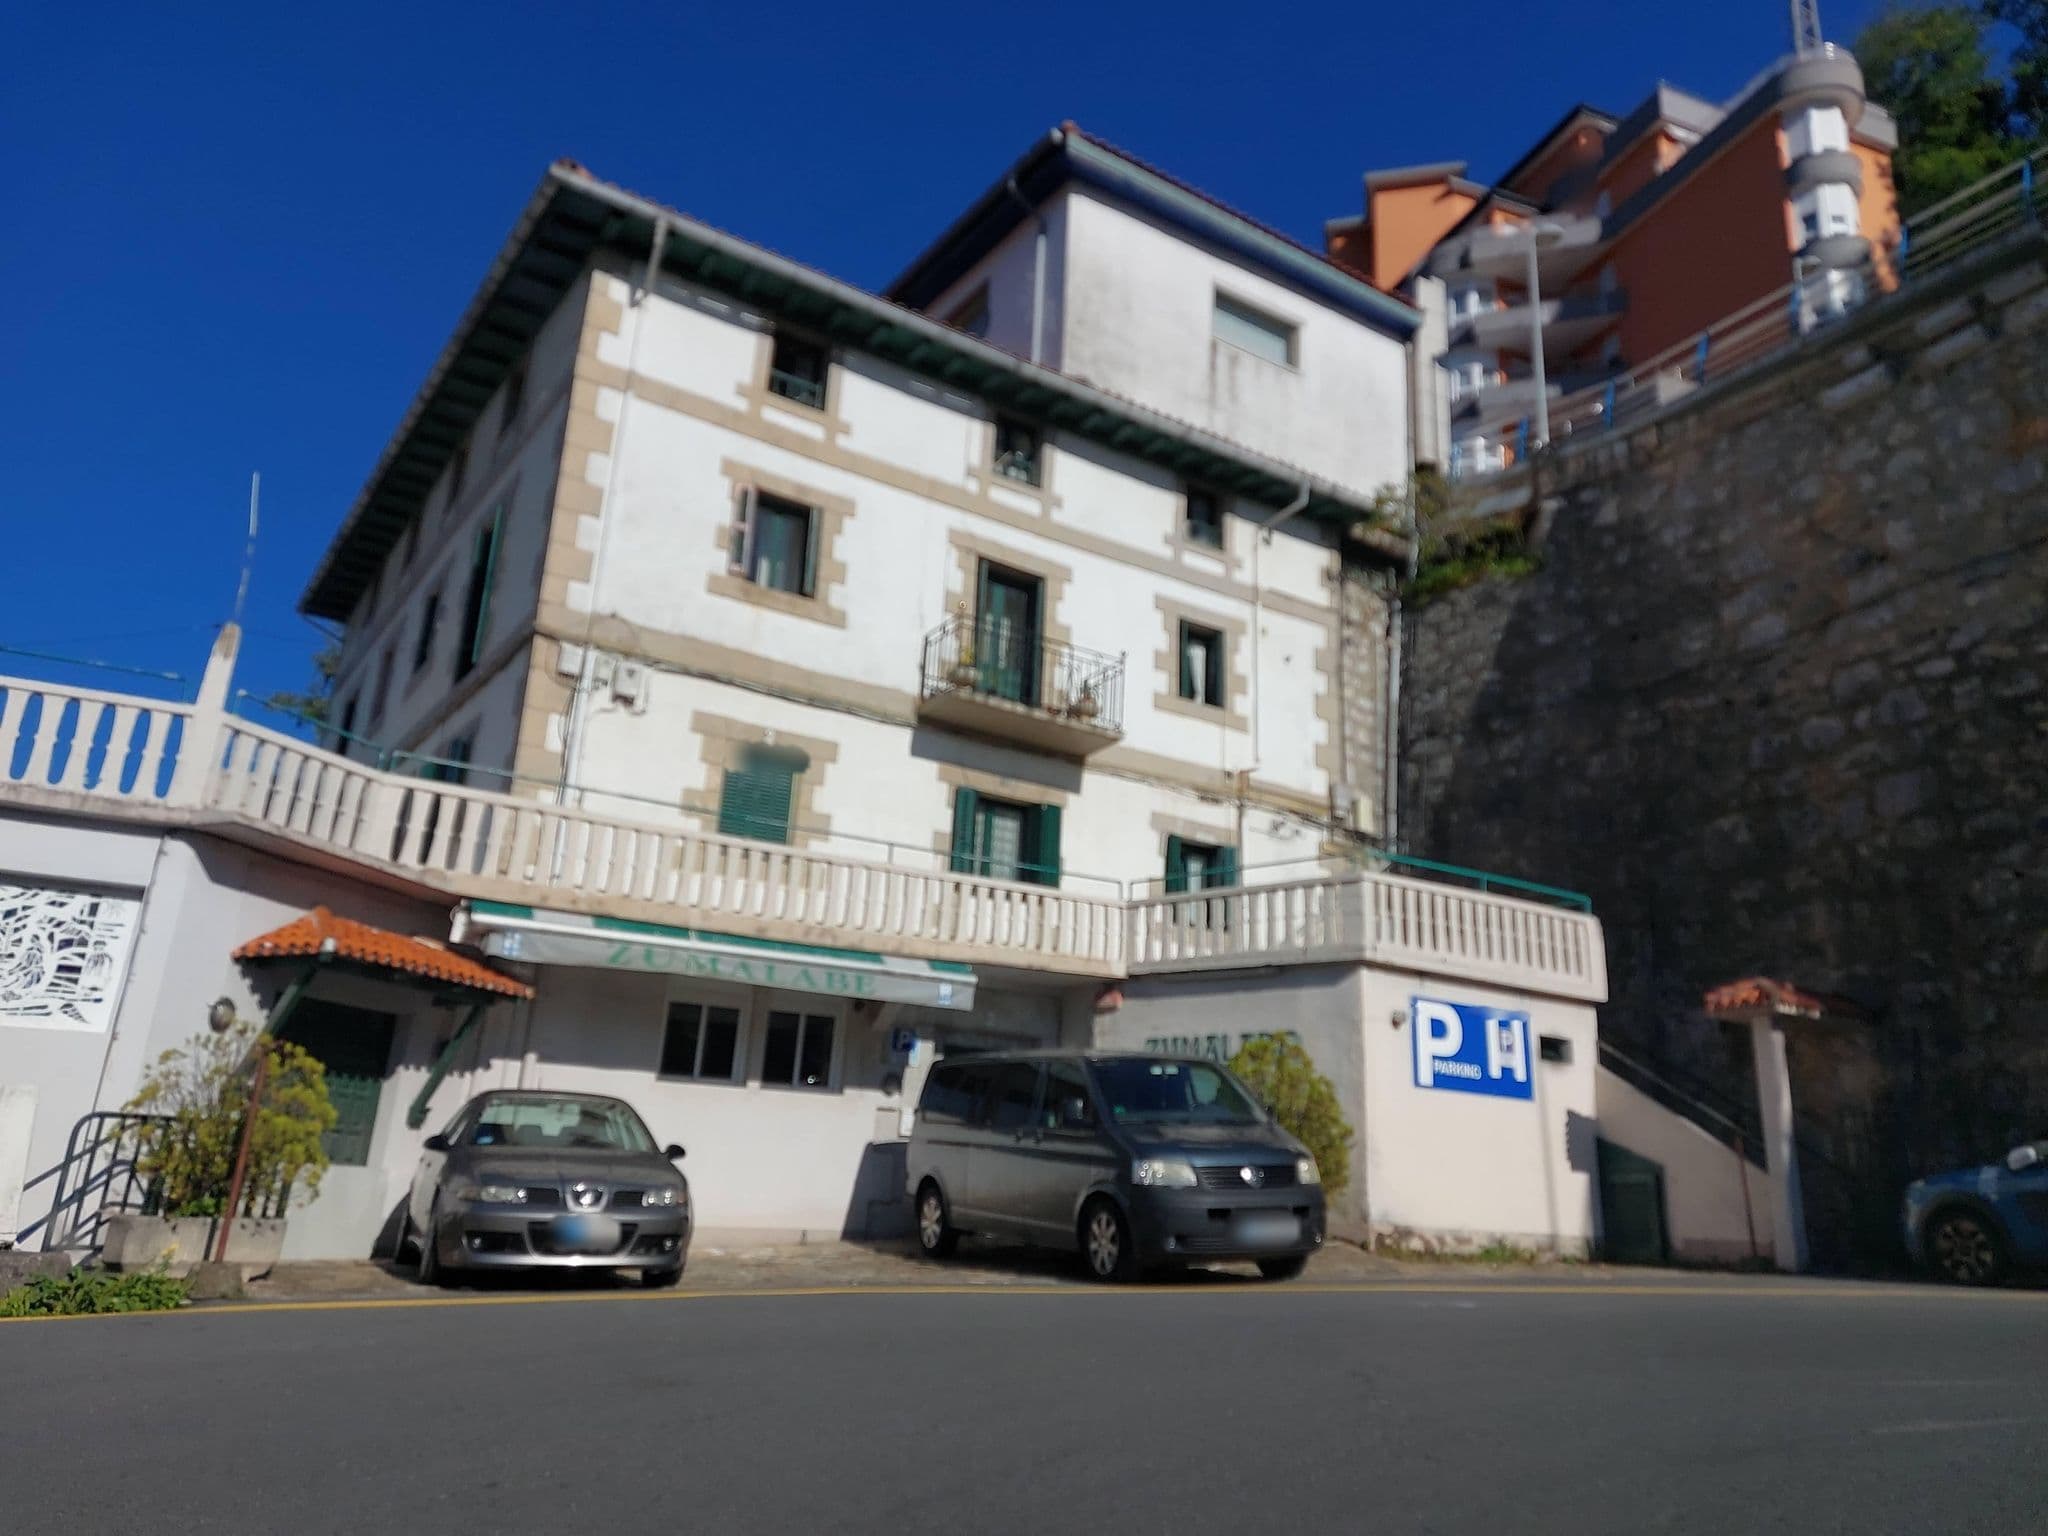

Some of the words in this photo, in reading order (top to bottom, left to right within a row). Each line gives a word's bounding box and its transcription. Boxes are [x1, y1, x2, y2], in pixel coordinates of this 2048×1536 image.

[607, 942, 878, 995] ZUMALABE
[1415, 999, 1463, 1087] P
[1433, 1059, 1482, 1080] PARKING
